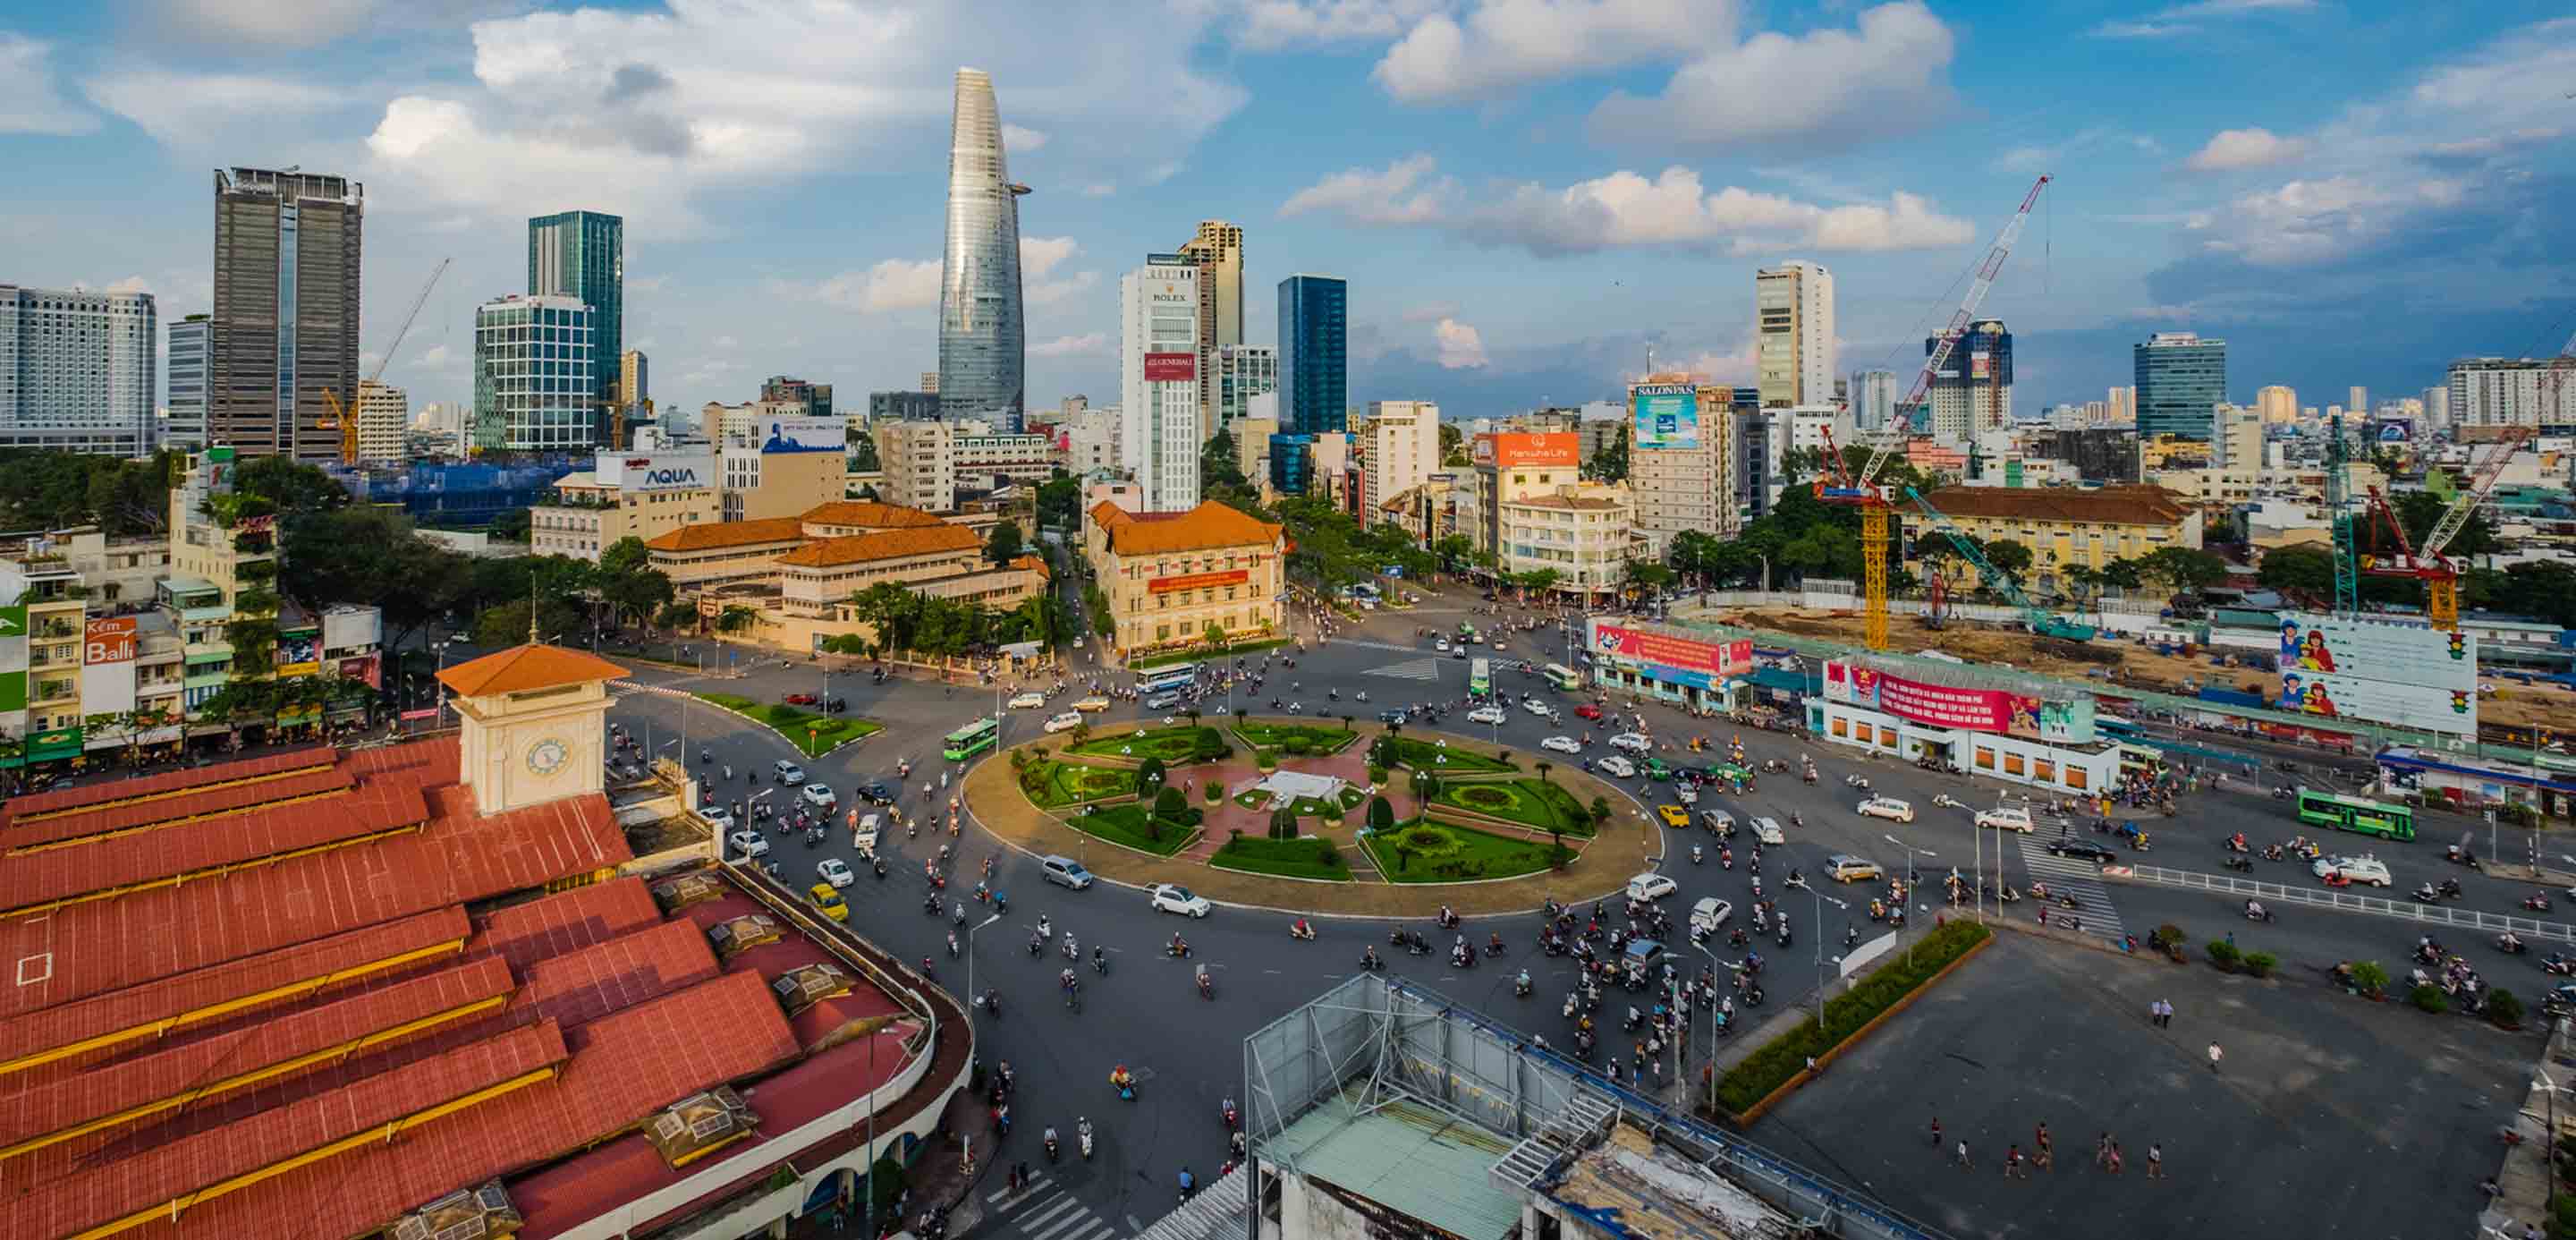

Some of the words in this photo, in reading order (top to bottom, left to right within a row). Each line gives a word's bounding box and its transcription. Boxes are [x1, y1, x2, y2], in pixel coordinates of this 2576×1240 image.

[1154, 293, 1186, 302] ROLEX
[1638, 386, 1694, 395] SALONPAS
[645, 468, 695, 485] AQUA
